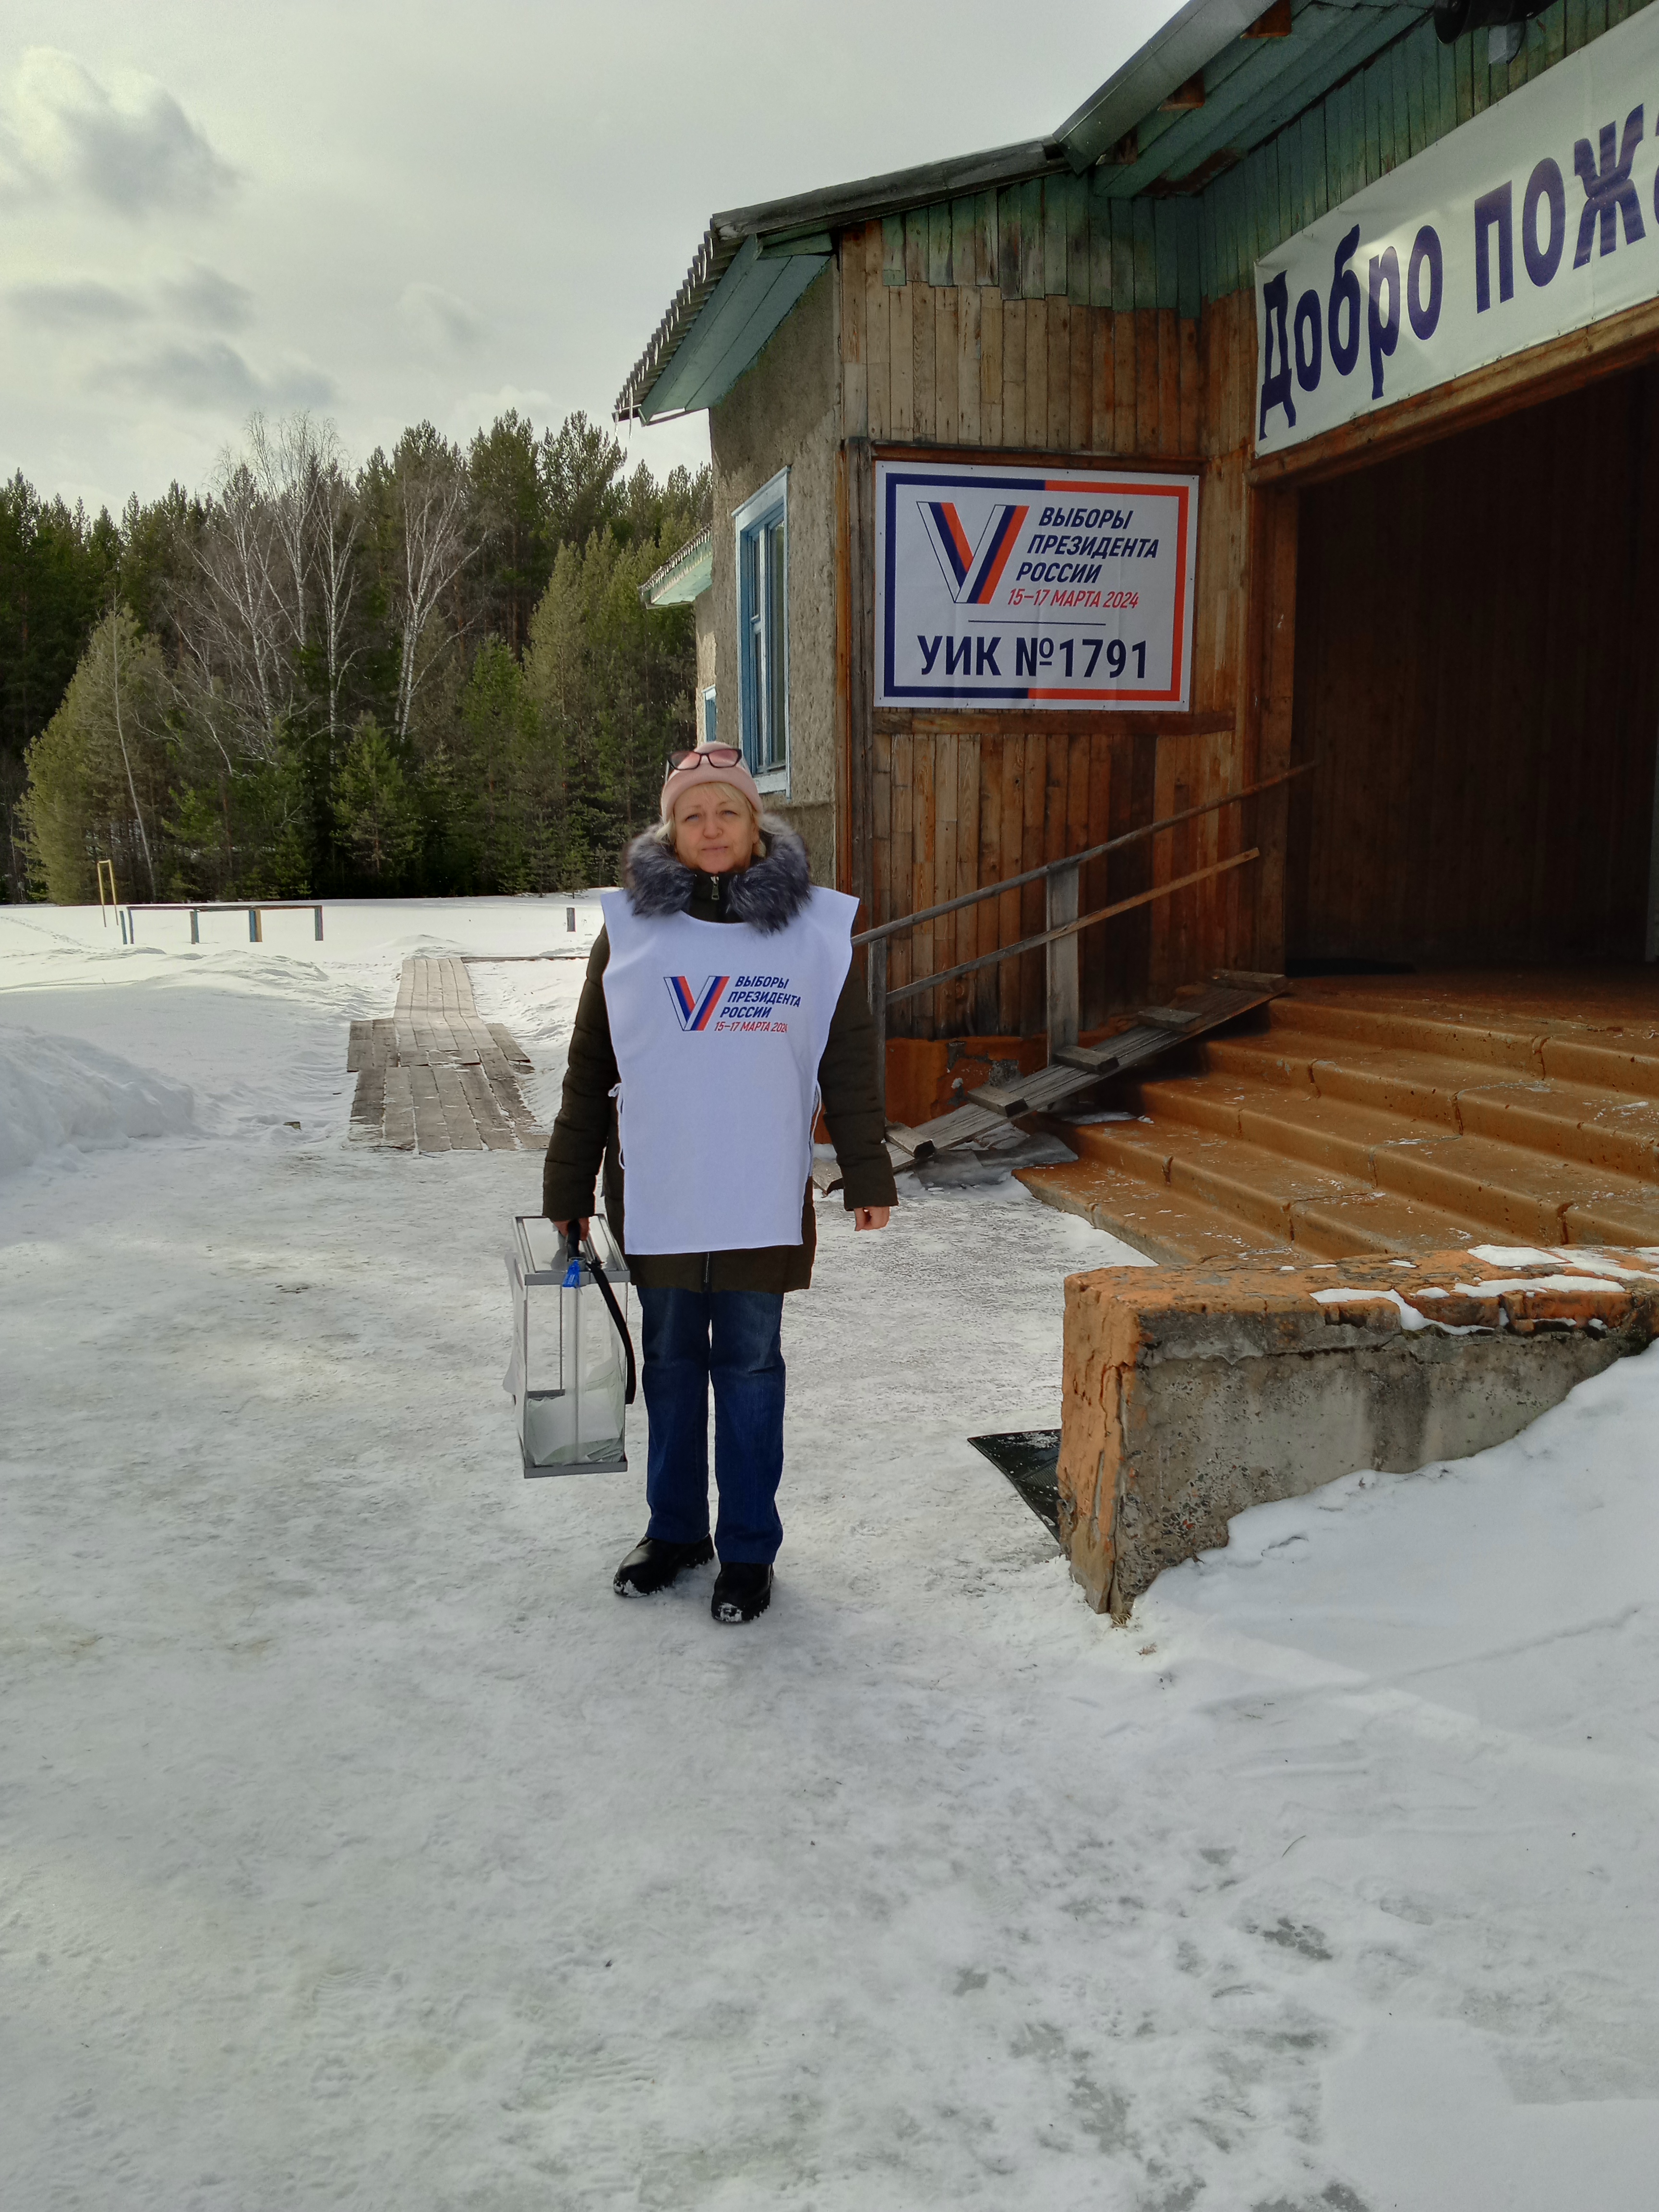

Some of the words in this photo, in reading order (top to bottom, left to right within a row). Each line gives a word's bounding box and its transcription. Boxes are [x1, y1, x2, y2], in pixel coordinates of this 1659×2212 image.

[1259, 224, 1443, 442] Добро
[1038, 506, 1133, 529] ВЫБОРЫ
[1026, 534, 1159, 560] ПРЕЗИДЕНТА
[1015, 562, 1103, 584] РОССИИ
[1049, 589, 1101, 608] МАРТА
[1102, 591, 1140, 609] 2024
[916, 635, 1002, 676] УИК
[735, 976, 790, 989] ВЫБОРЫ
[727, 991, 801, 1008] ПРЕЗИДЕНТА
[720, 1007, 772, 1018] РОССИИ
[740, 1022, 771, 1032] МАРТА
